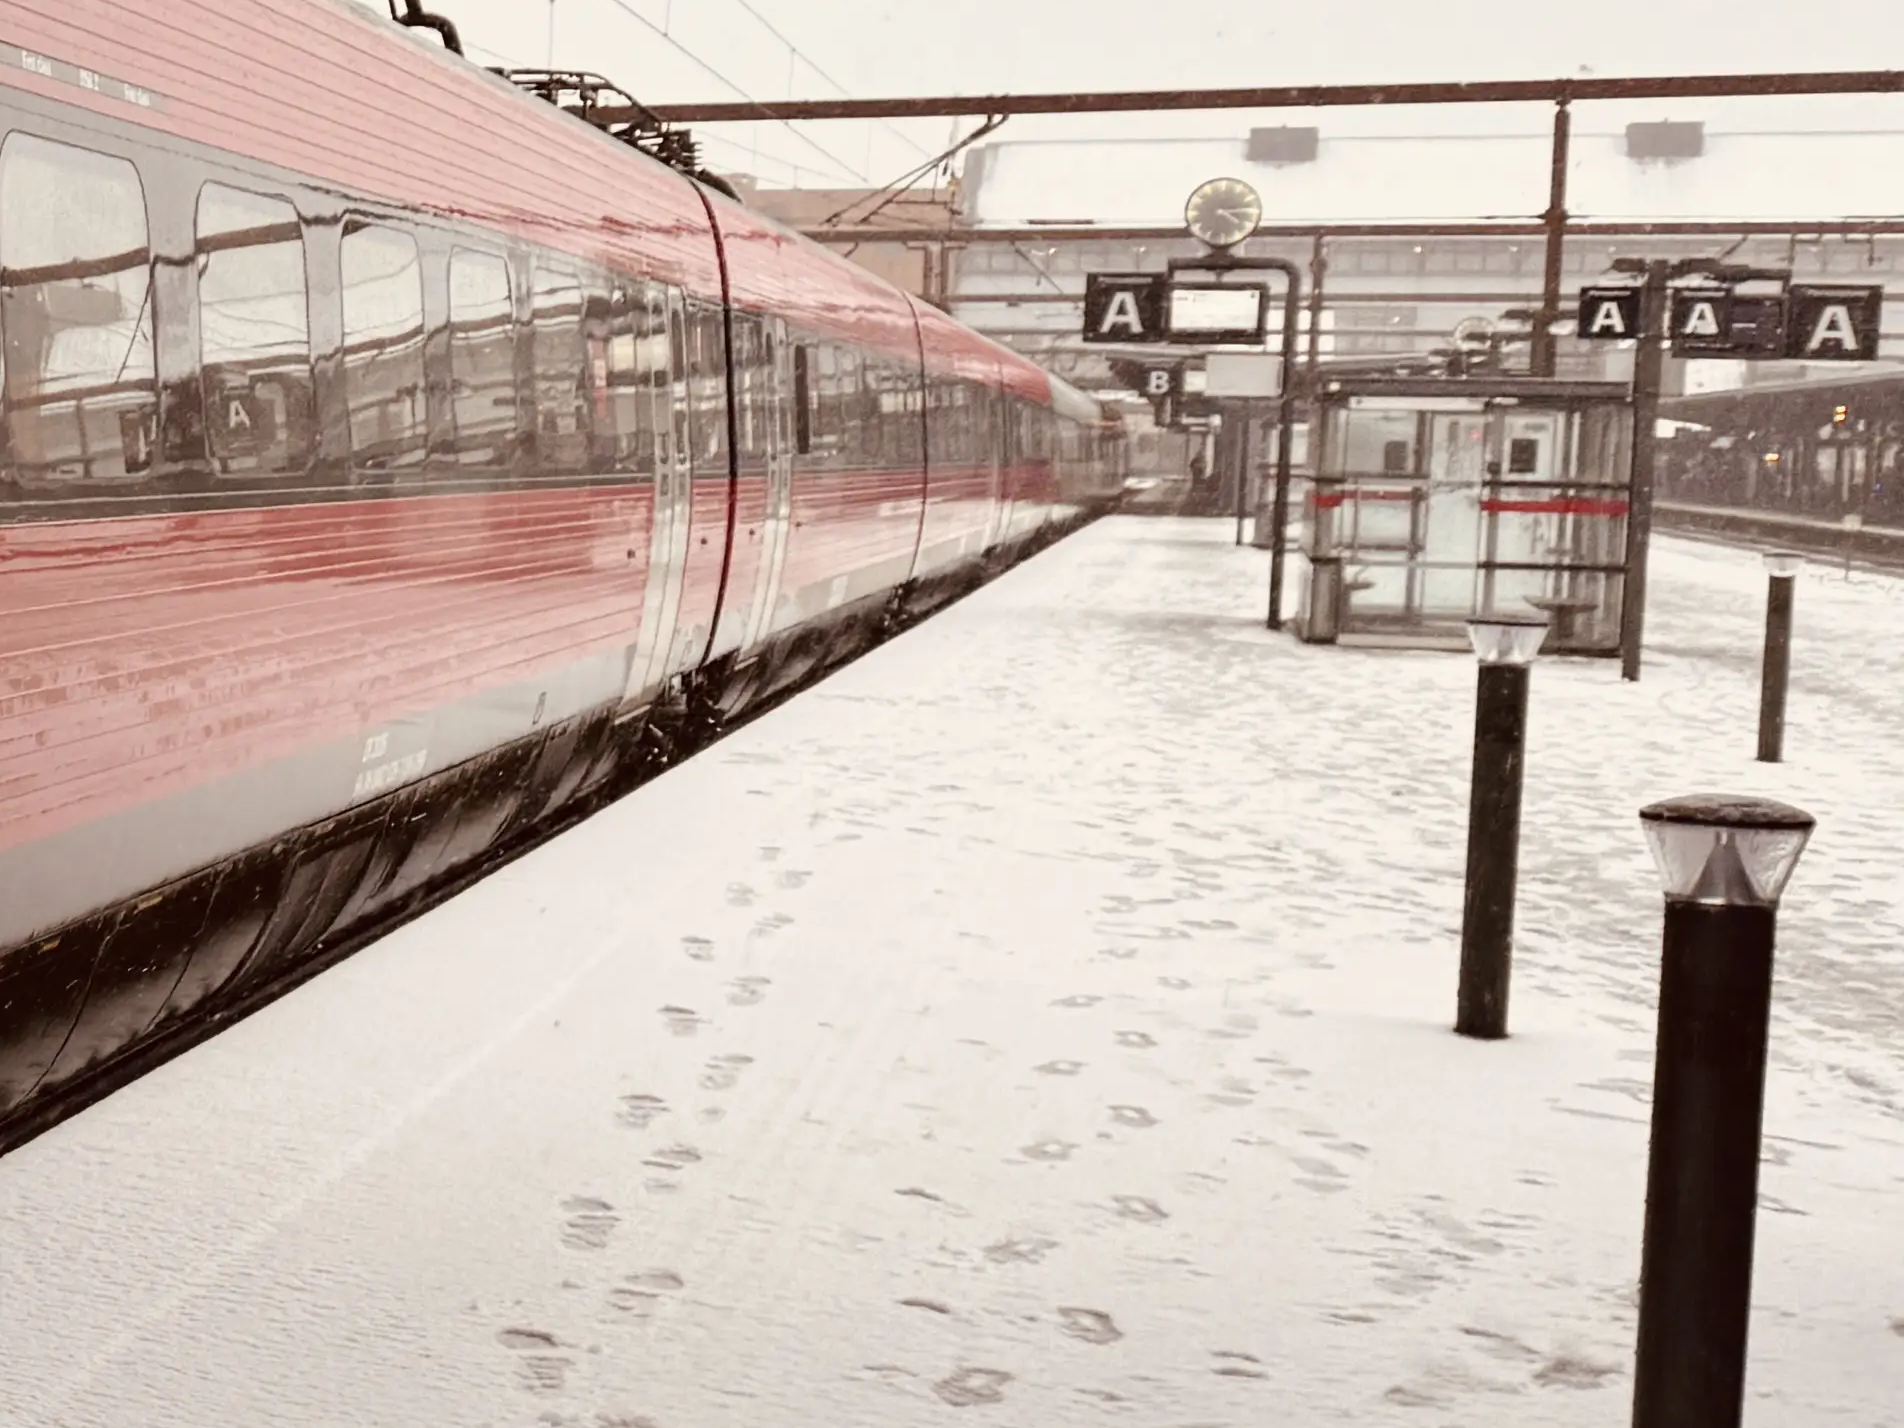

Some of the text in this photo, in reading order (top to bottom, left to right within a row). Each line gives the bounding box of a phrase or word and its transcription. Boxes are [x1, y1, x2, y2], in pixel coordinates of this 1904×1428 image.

[1099, 291, 1144, 333] A
[1591, 301, 1626, 333] A
[1685, 302, 1720, 334] A
[1805, 305, 1859, 351] A
[1148, 371, 1170, 394] B
